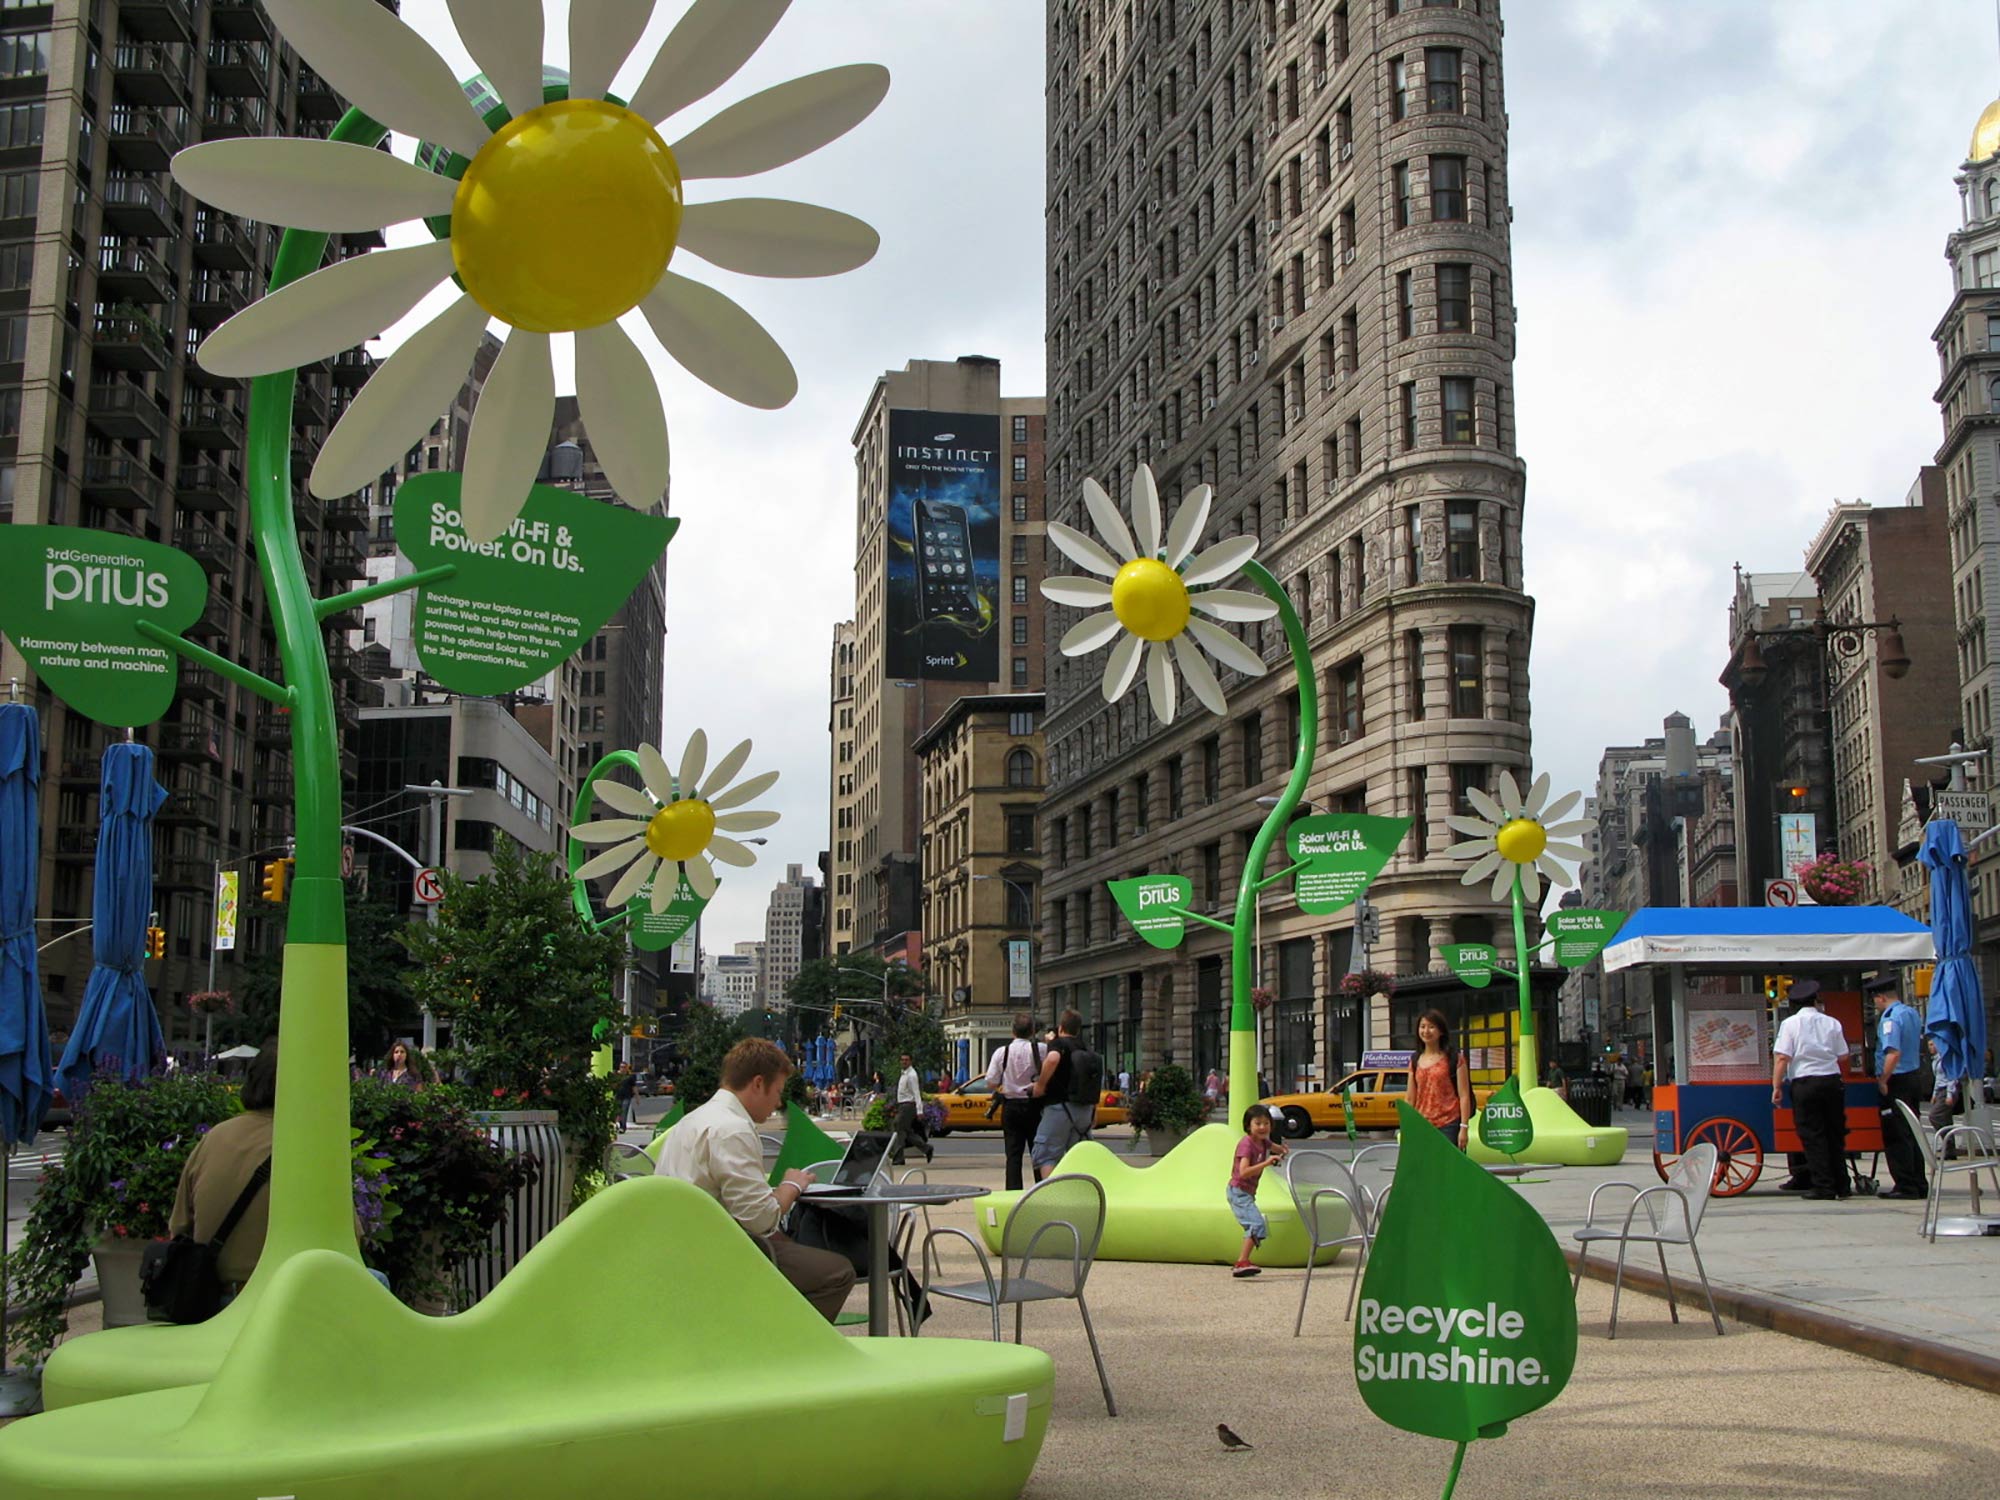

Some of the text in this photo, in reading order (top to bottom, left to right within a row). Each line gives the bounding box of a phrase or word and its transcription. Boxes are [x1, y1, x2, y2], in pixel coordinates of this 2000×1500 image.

[898, 446, 992, 462] INSTINCT
[555, 526, 573, 548] &
[46, 547, 144, 567] 3rdGeneration
[430, 525, 585, 573] Power. On Us.
[46, 563, 168, 610] prius
[427, 592, 581, 627] Recharge your laptop or cell phone,
[426, 606, 578, 638] surf the Web and stay awhile. It's all
[424, 620, 562, 649] powered with help from the sun,
[424, 631, 549, 659] like the optional Solar Roof in
[20, 637, 169, 659] Harmony between man,
[423, 645, 529, 669] the 3rd generation Prius.
[40, 655, 169, 673] nature and machine.
[925, 655, 954, 667] Sprint
[1939, 796, 1986, 808] PASSENGER
[1967, 811, 1986, 823] ONLY
[1299, 830, 1361, 844] Solar Wi-Fi &
[1299, 840, 1367, 854] Power. On Us.
[1139, 887, 1180, 910] prius
[1459, 950, 1488, 964] prius
[1486, 1106, 1523, 1123] prius
[1360, 1298, 1524, 1343] Recycle
[1358, 1344, 1549, 1386] Sunshine.
